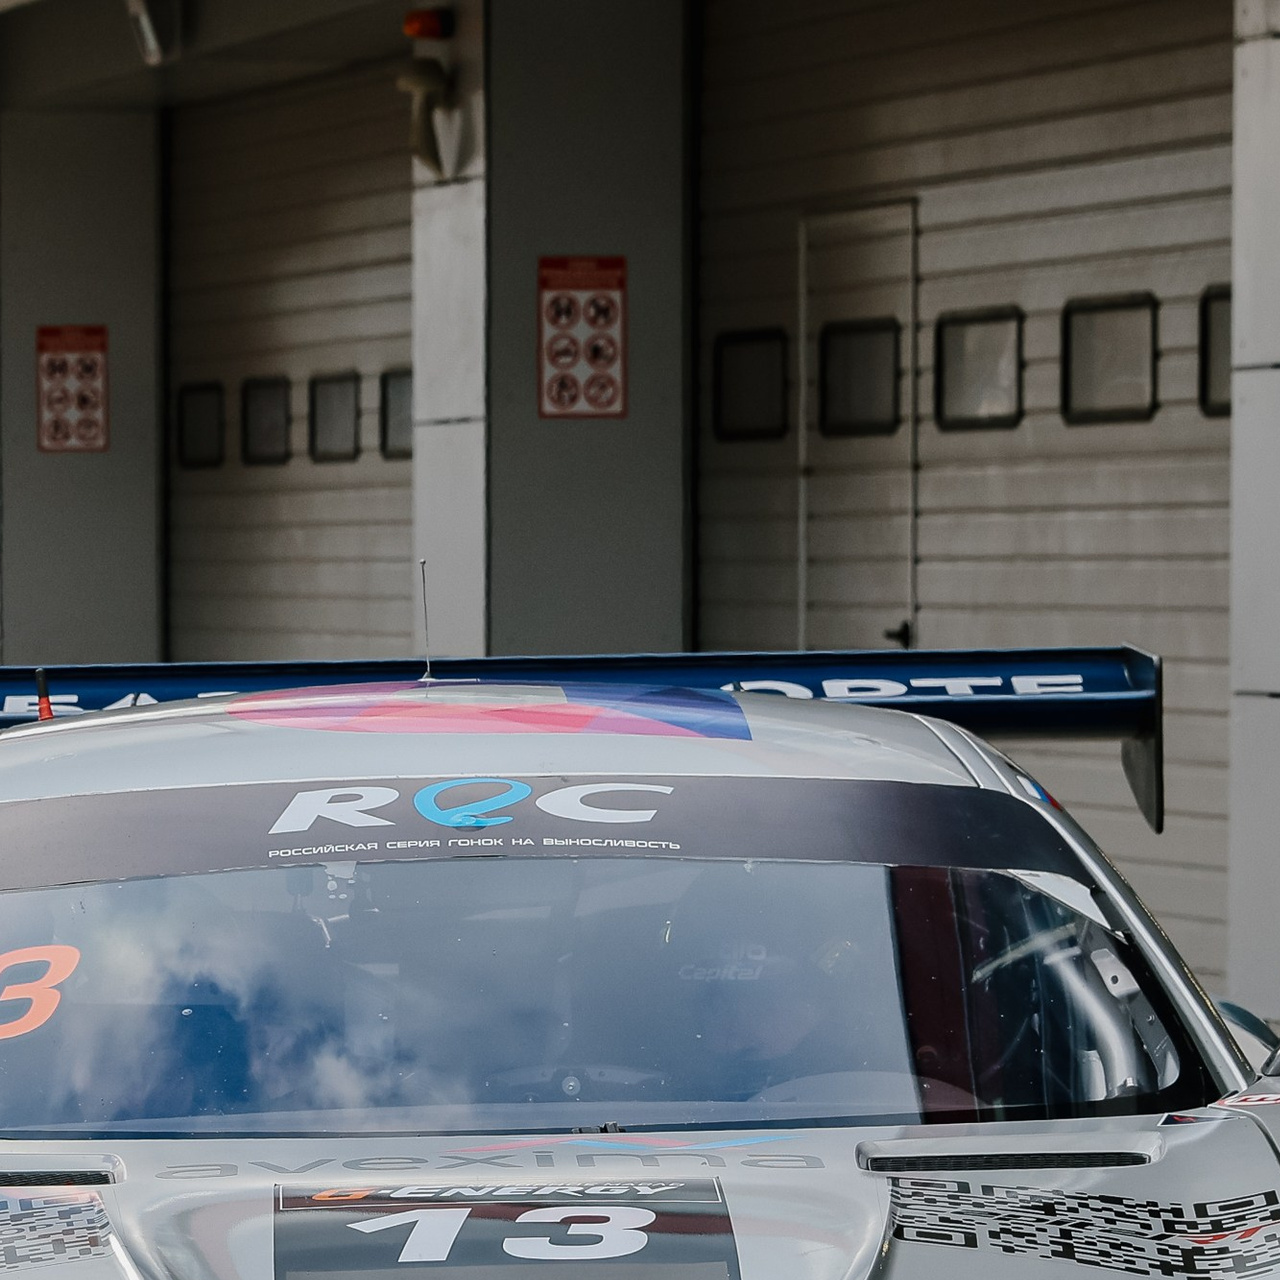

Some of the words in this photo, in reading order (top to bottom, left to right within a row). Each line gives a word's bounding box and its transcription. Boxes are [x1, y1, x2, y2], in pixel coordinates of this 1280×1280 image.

[268, 841, 378, 858] РОССИЙСКАЯ
[386, 838, 440, 849] СЕРИЯ
[448, 837, 503, 848] ГОНОК
[511, 837, 535, 847] НА
[543, 837, 681, 850] ВЫНОСЛИВОСТЬ
[155, 1150, 826, 1181] avexima
[311, 1186, 680, 1201] G-ENERGY
[346, 1205, 656, 1263] 13
